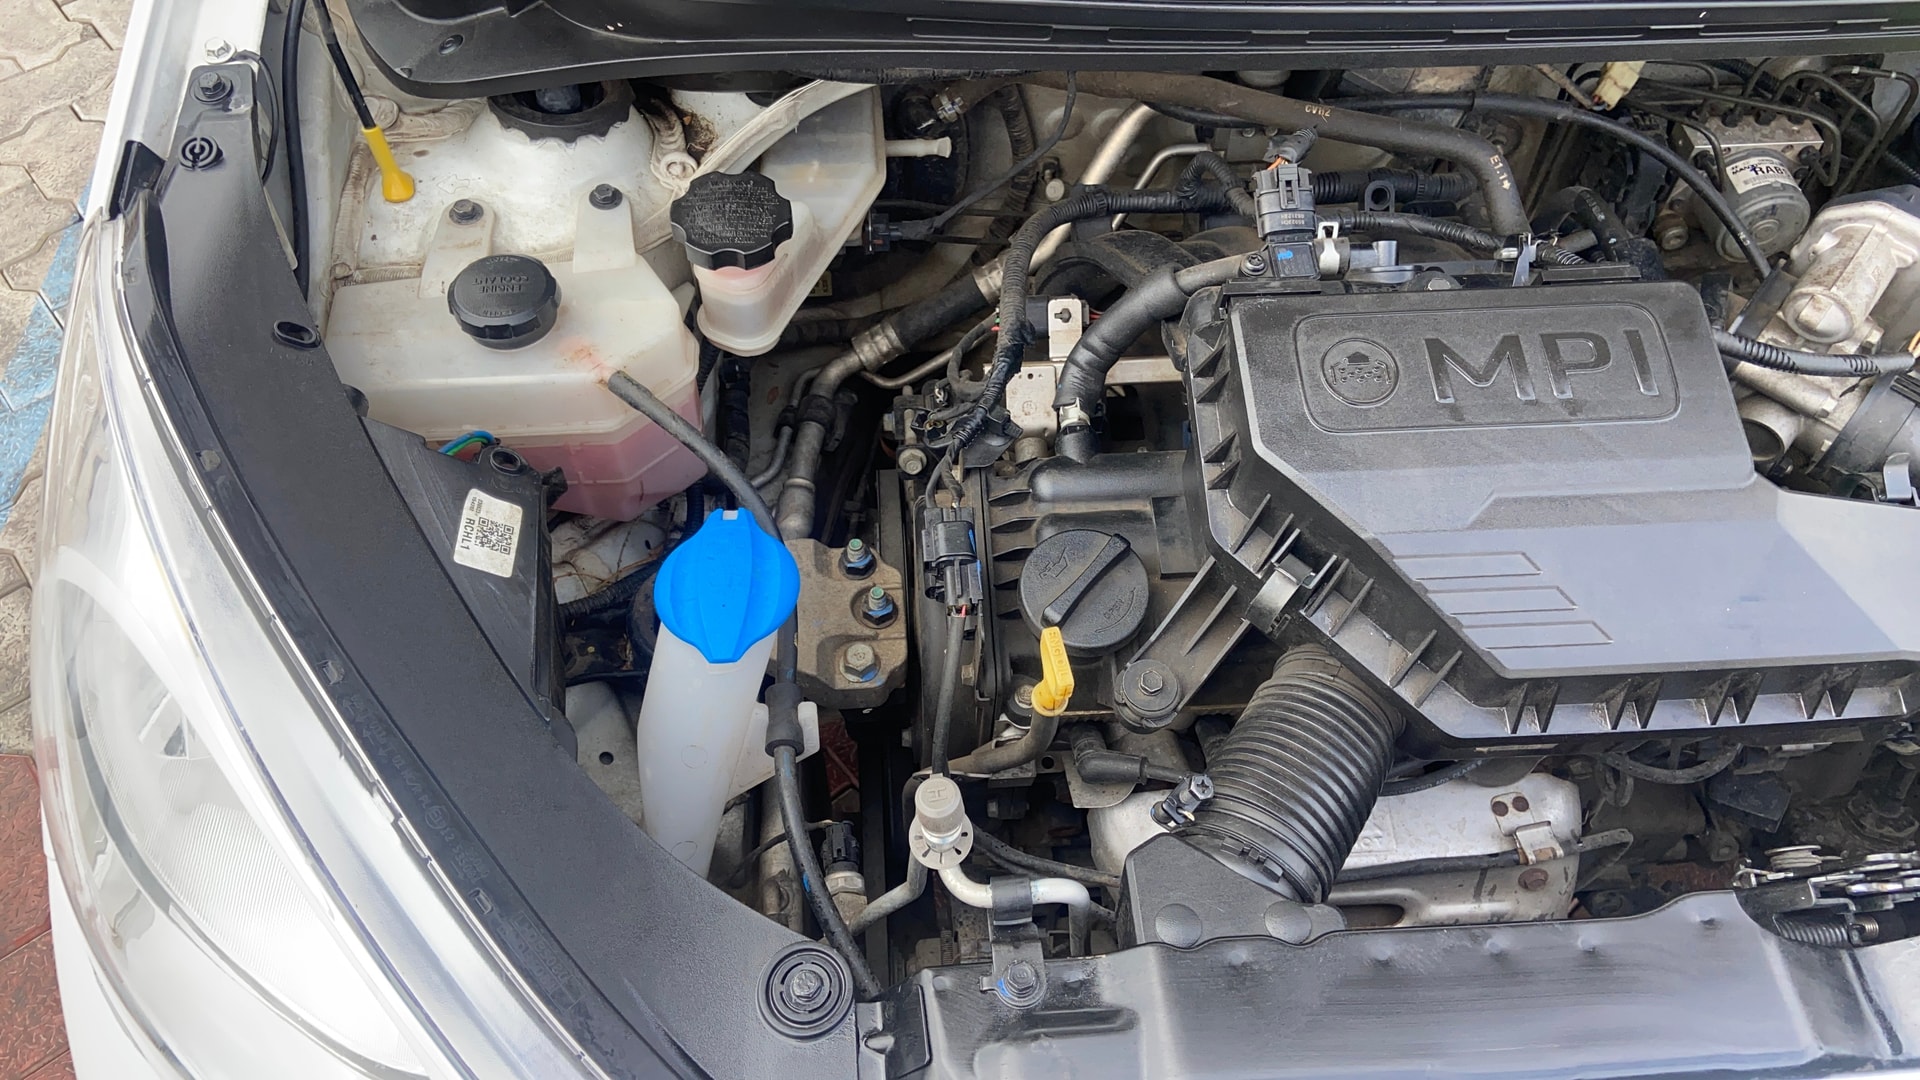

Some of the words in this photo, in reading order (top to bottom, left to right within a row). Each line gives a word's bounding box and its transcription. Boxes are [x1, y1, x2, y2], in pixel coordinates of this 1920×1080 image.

[472, 275, 529, 286] COOLANT
[480, 284, 522, 294] ENGINE
[1423, 329, 1660, 404] MPI
[460, 517, 476, 551] RCHL1
[1048, 631, 1061, 657] ENG
[1058, 659, 1069, 676] OIL
